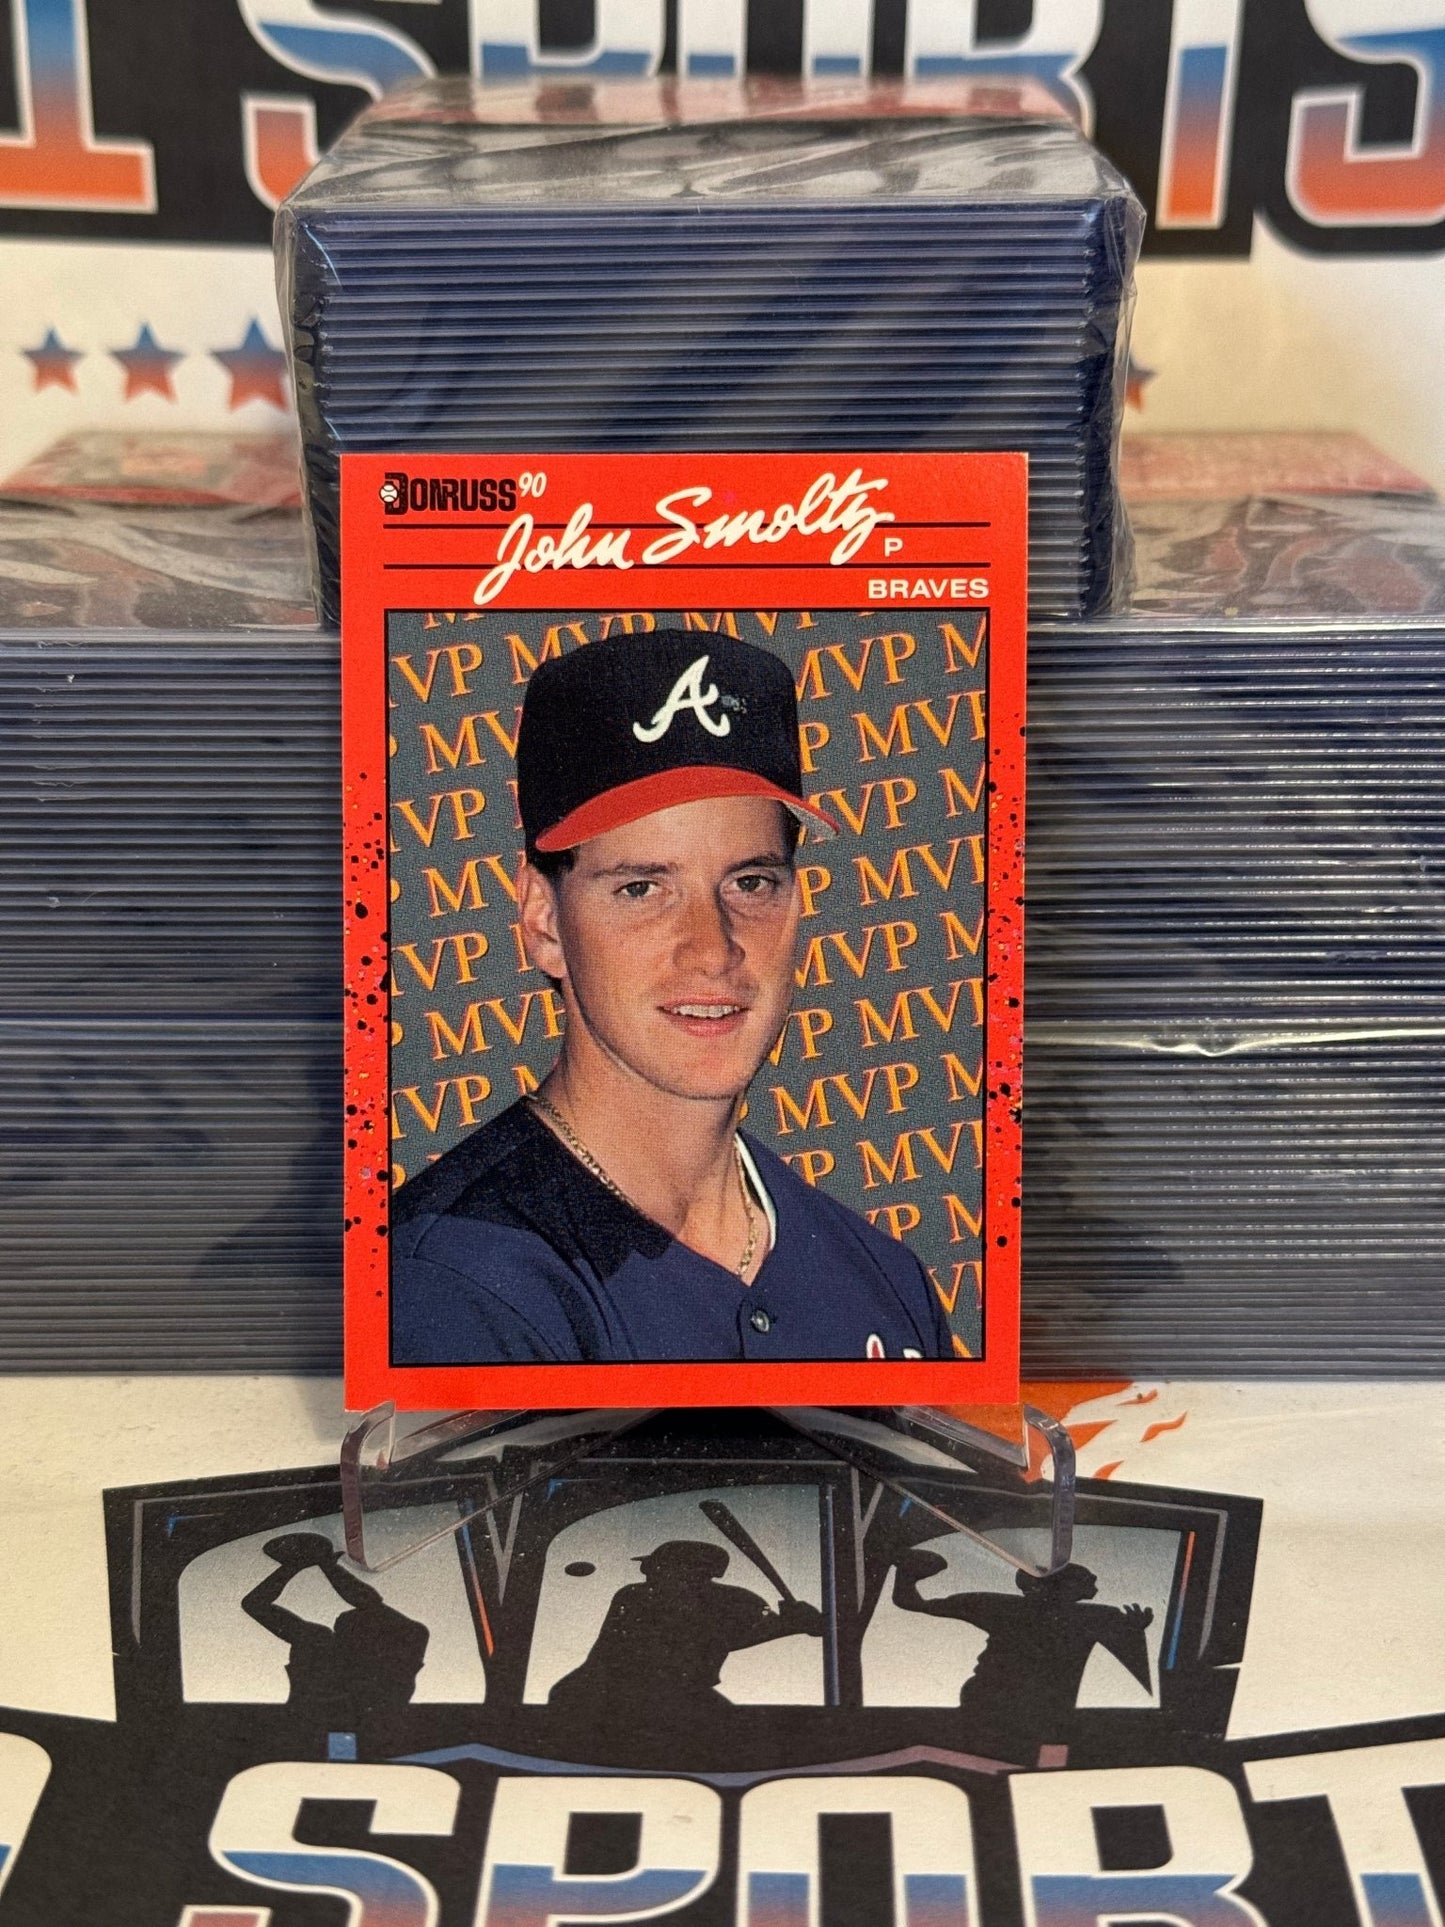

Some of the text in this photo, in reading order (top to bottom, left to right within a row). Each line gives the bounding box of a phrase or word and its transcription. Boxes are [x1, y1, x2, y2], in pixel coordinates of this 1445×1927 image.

[379, 471, 548, 516] DONRUSS 90
[472, 467, 896, 606] John Smoltz
[883, 536, 904, 557] P
[867, 577, 990, 599] BRAVES
[389, 643, 484, 708] VP
[632, 654, 731, 743] A
[419, 704, 525, 776] MV
[389, 787, 487, 854] VP
[768, 1061, 921, 1136] MVP
